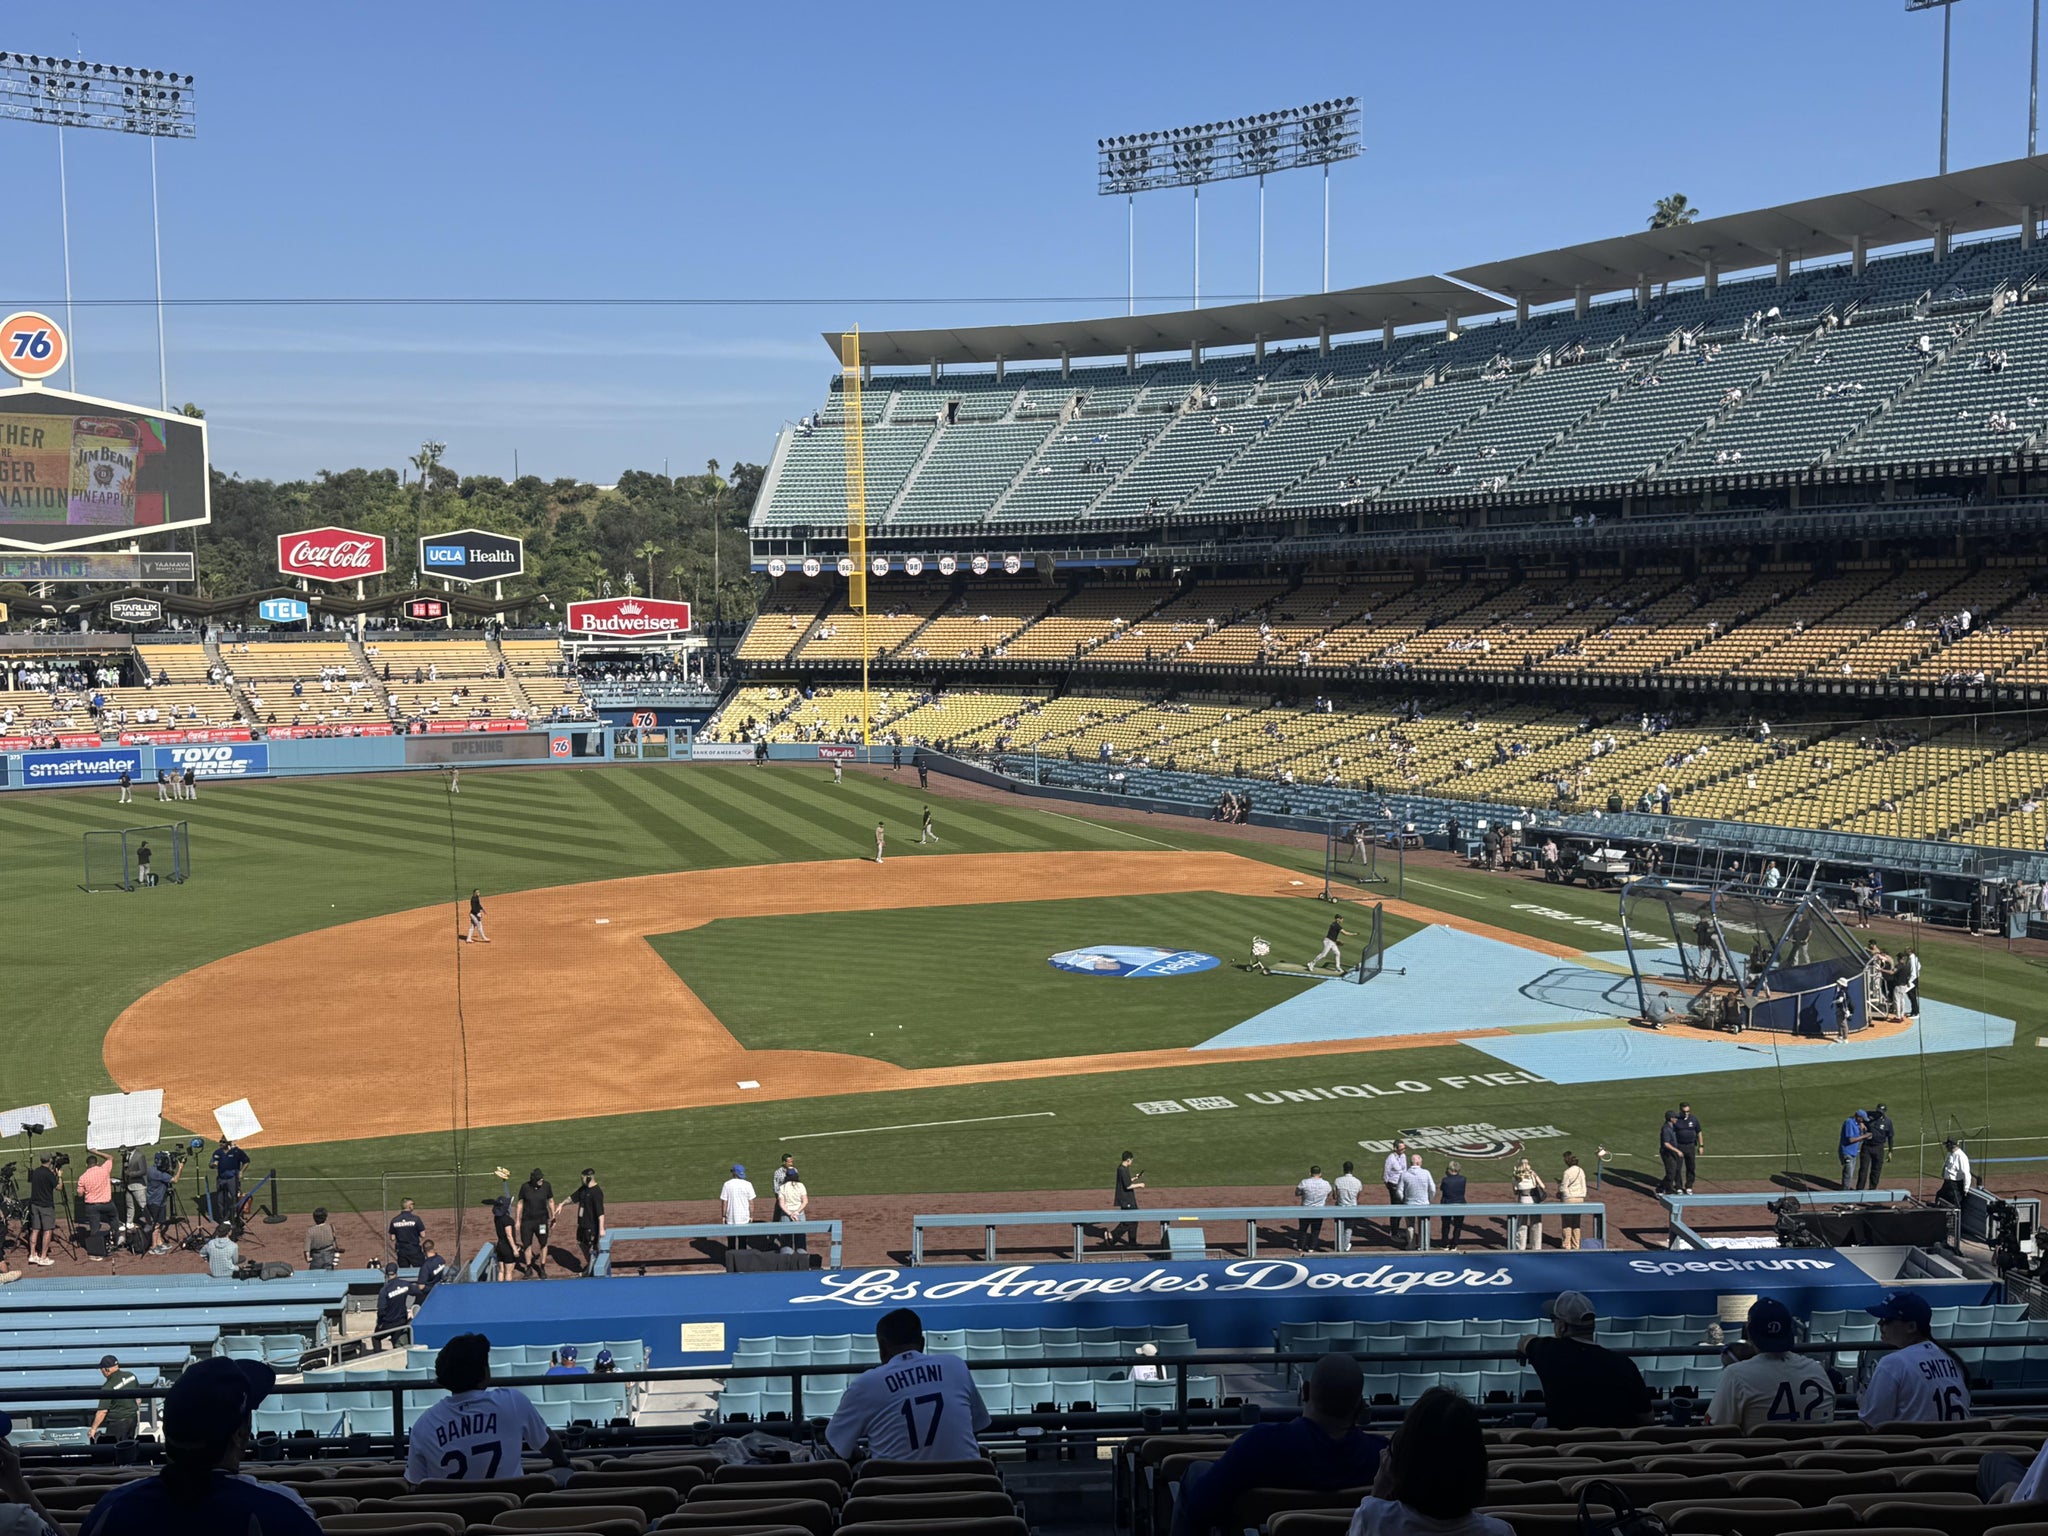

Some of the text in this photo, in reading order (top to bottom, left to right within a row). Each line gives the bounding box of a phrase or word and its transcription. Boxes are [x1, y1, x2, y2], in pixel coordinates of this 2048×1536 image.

[10, 328, 53, 360] 76
[76, 446, 133, 473] JIM BEAM
[289, 540, 375, 568] Coca-Cola
[430, 549, 515, 563] UCLA Health
[265, 602, 302, 618] TEL
[580, 613, 679, 630] Budweiser
[636, 712, 654, 727] 76
[171, 747, 233, 762] TOYO
[452, 740, 503, 754] OPENING
[553, 740, 568, 752] 76
[29, 758, 135, 777] smartwater
[181, 759, 248, 775] TIRES
[1245, 1080, 1432, 1105] UNIQLO
[1446, 1123, 1497, 1134] 2026
[1487, 1126, 1571, 1143] WEEK
[1629, 1258, 1826, 1276] Spectrum
[789, 1259, 1513, 1305] Los Angeles Dodgers
[1767, 1321, 1781, 1333] D
[885, 1365, 943, 1393] OHTANI
[1919, 1359, 1958, 1380] SMITH
[1767, 1380, 1824, 1422] 42
[1933, 1386, 1966, 1421] 16
[435, 1413, 497, 1447] BANDA
[901, 1392, 944, 1450] 17
[440, 1440, 502, 1480] 27
